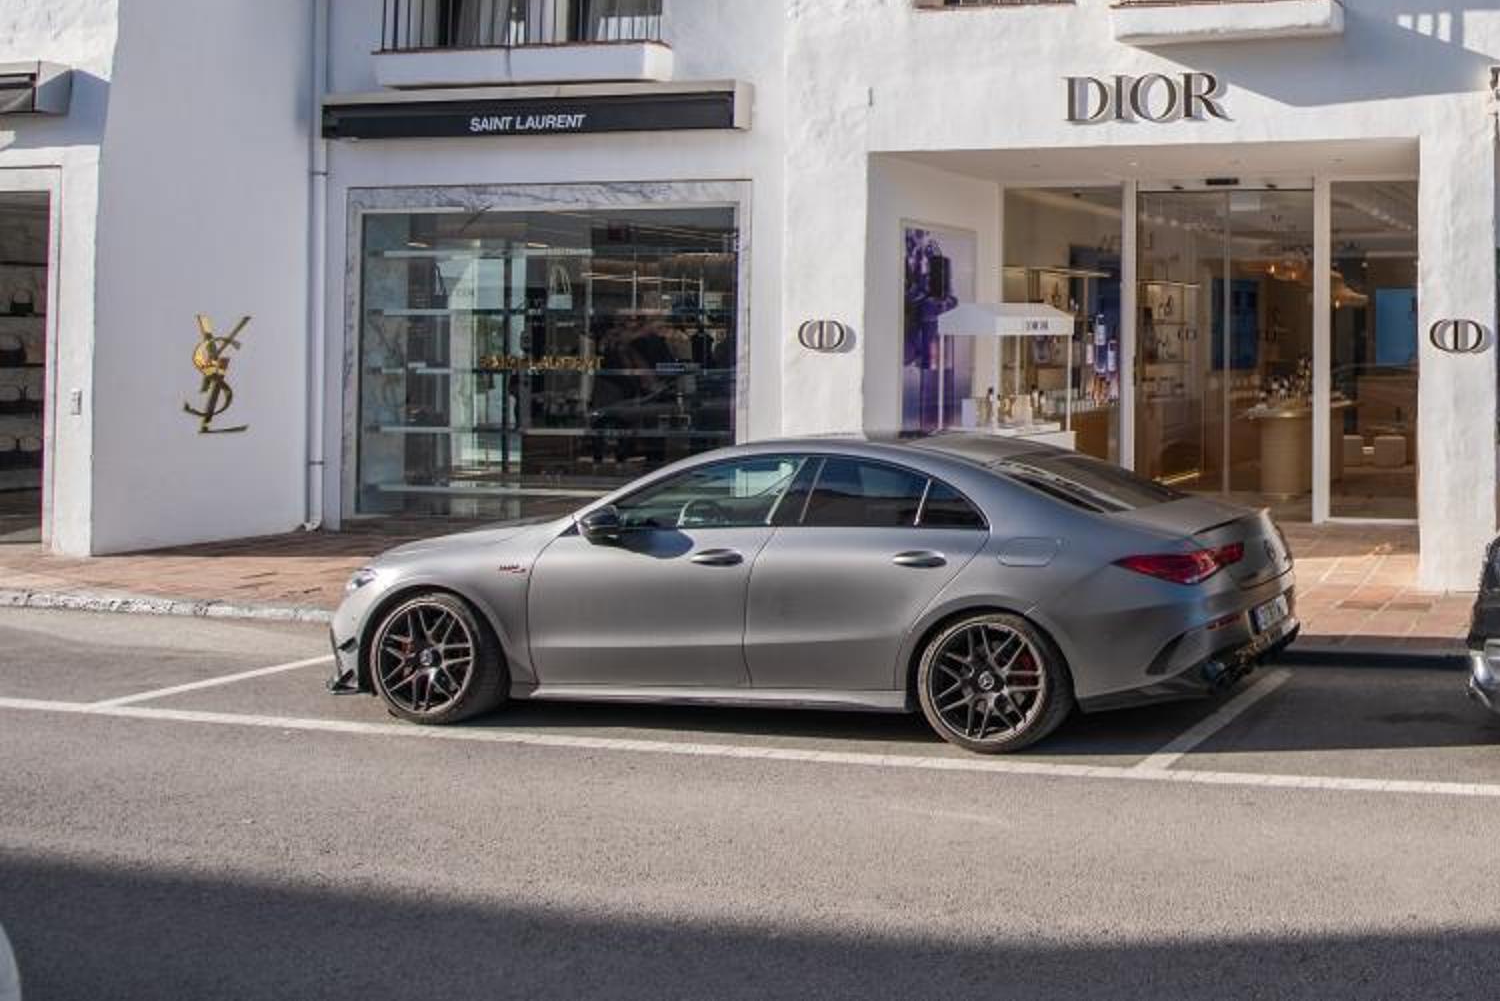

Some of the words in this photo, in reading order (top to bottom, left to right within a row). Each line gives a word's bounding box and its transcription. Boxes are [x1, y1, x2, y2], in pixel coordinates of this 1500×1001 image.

[1062, 73, 1235, 122] DIOR
[470, 116, 512, 132] SAINT
[515, 114, 586, 130] LAURENT
